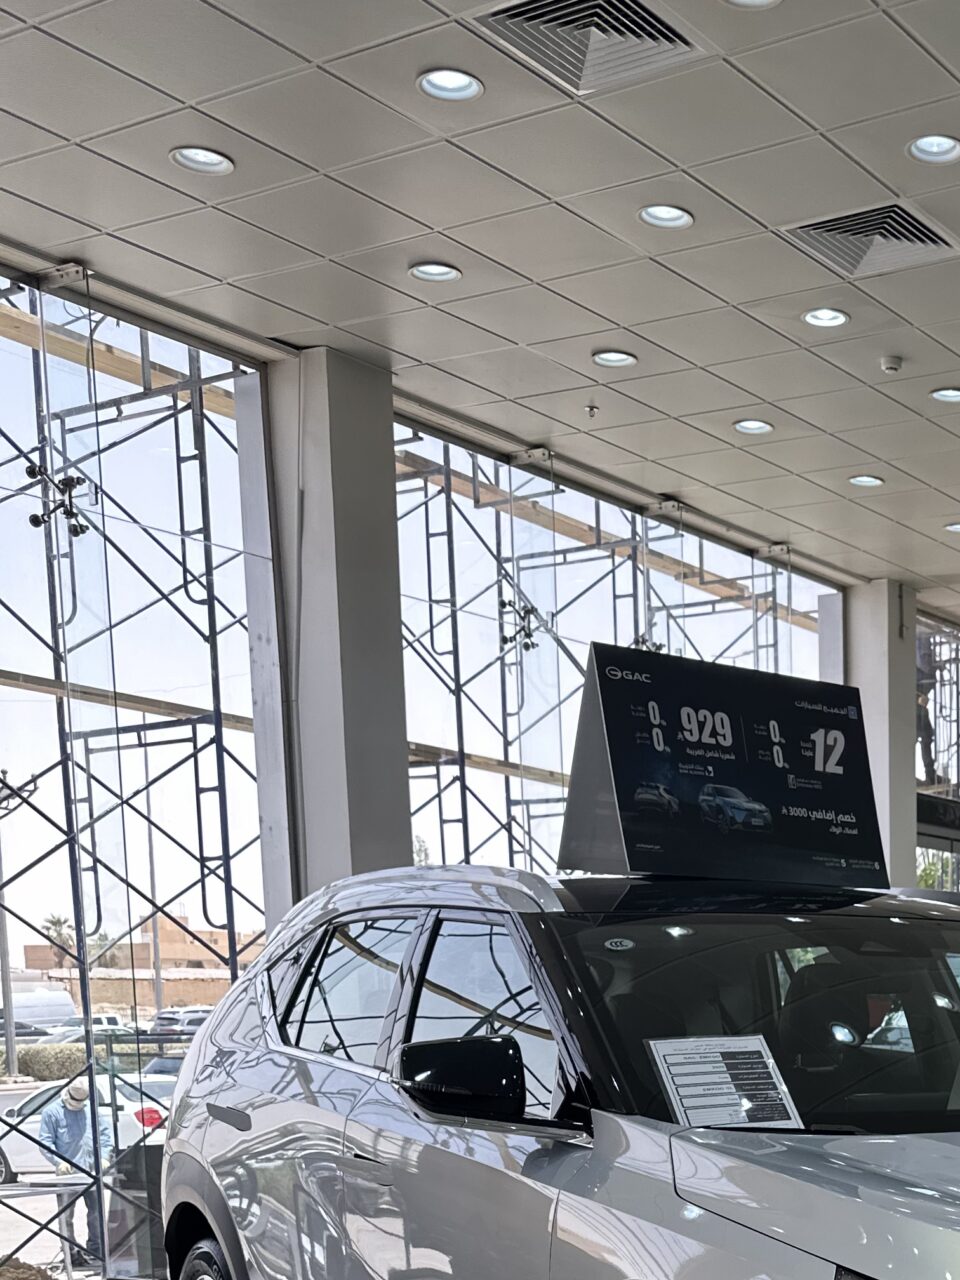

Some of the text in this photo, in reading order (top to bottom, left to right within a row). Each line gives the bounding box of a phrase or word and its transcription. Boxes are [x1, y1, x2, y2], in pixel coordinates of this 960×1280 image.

[622, 670, 651, 683] GAC
[680, 706, 733, 747] 929
[810, 728, 845, 774] 12
[789, 806, 808, 817] 3000
